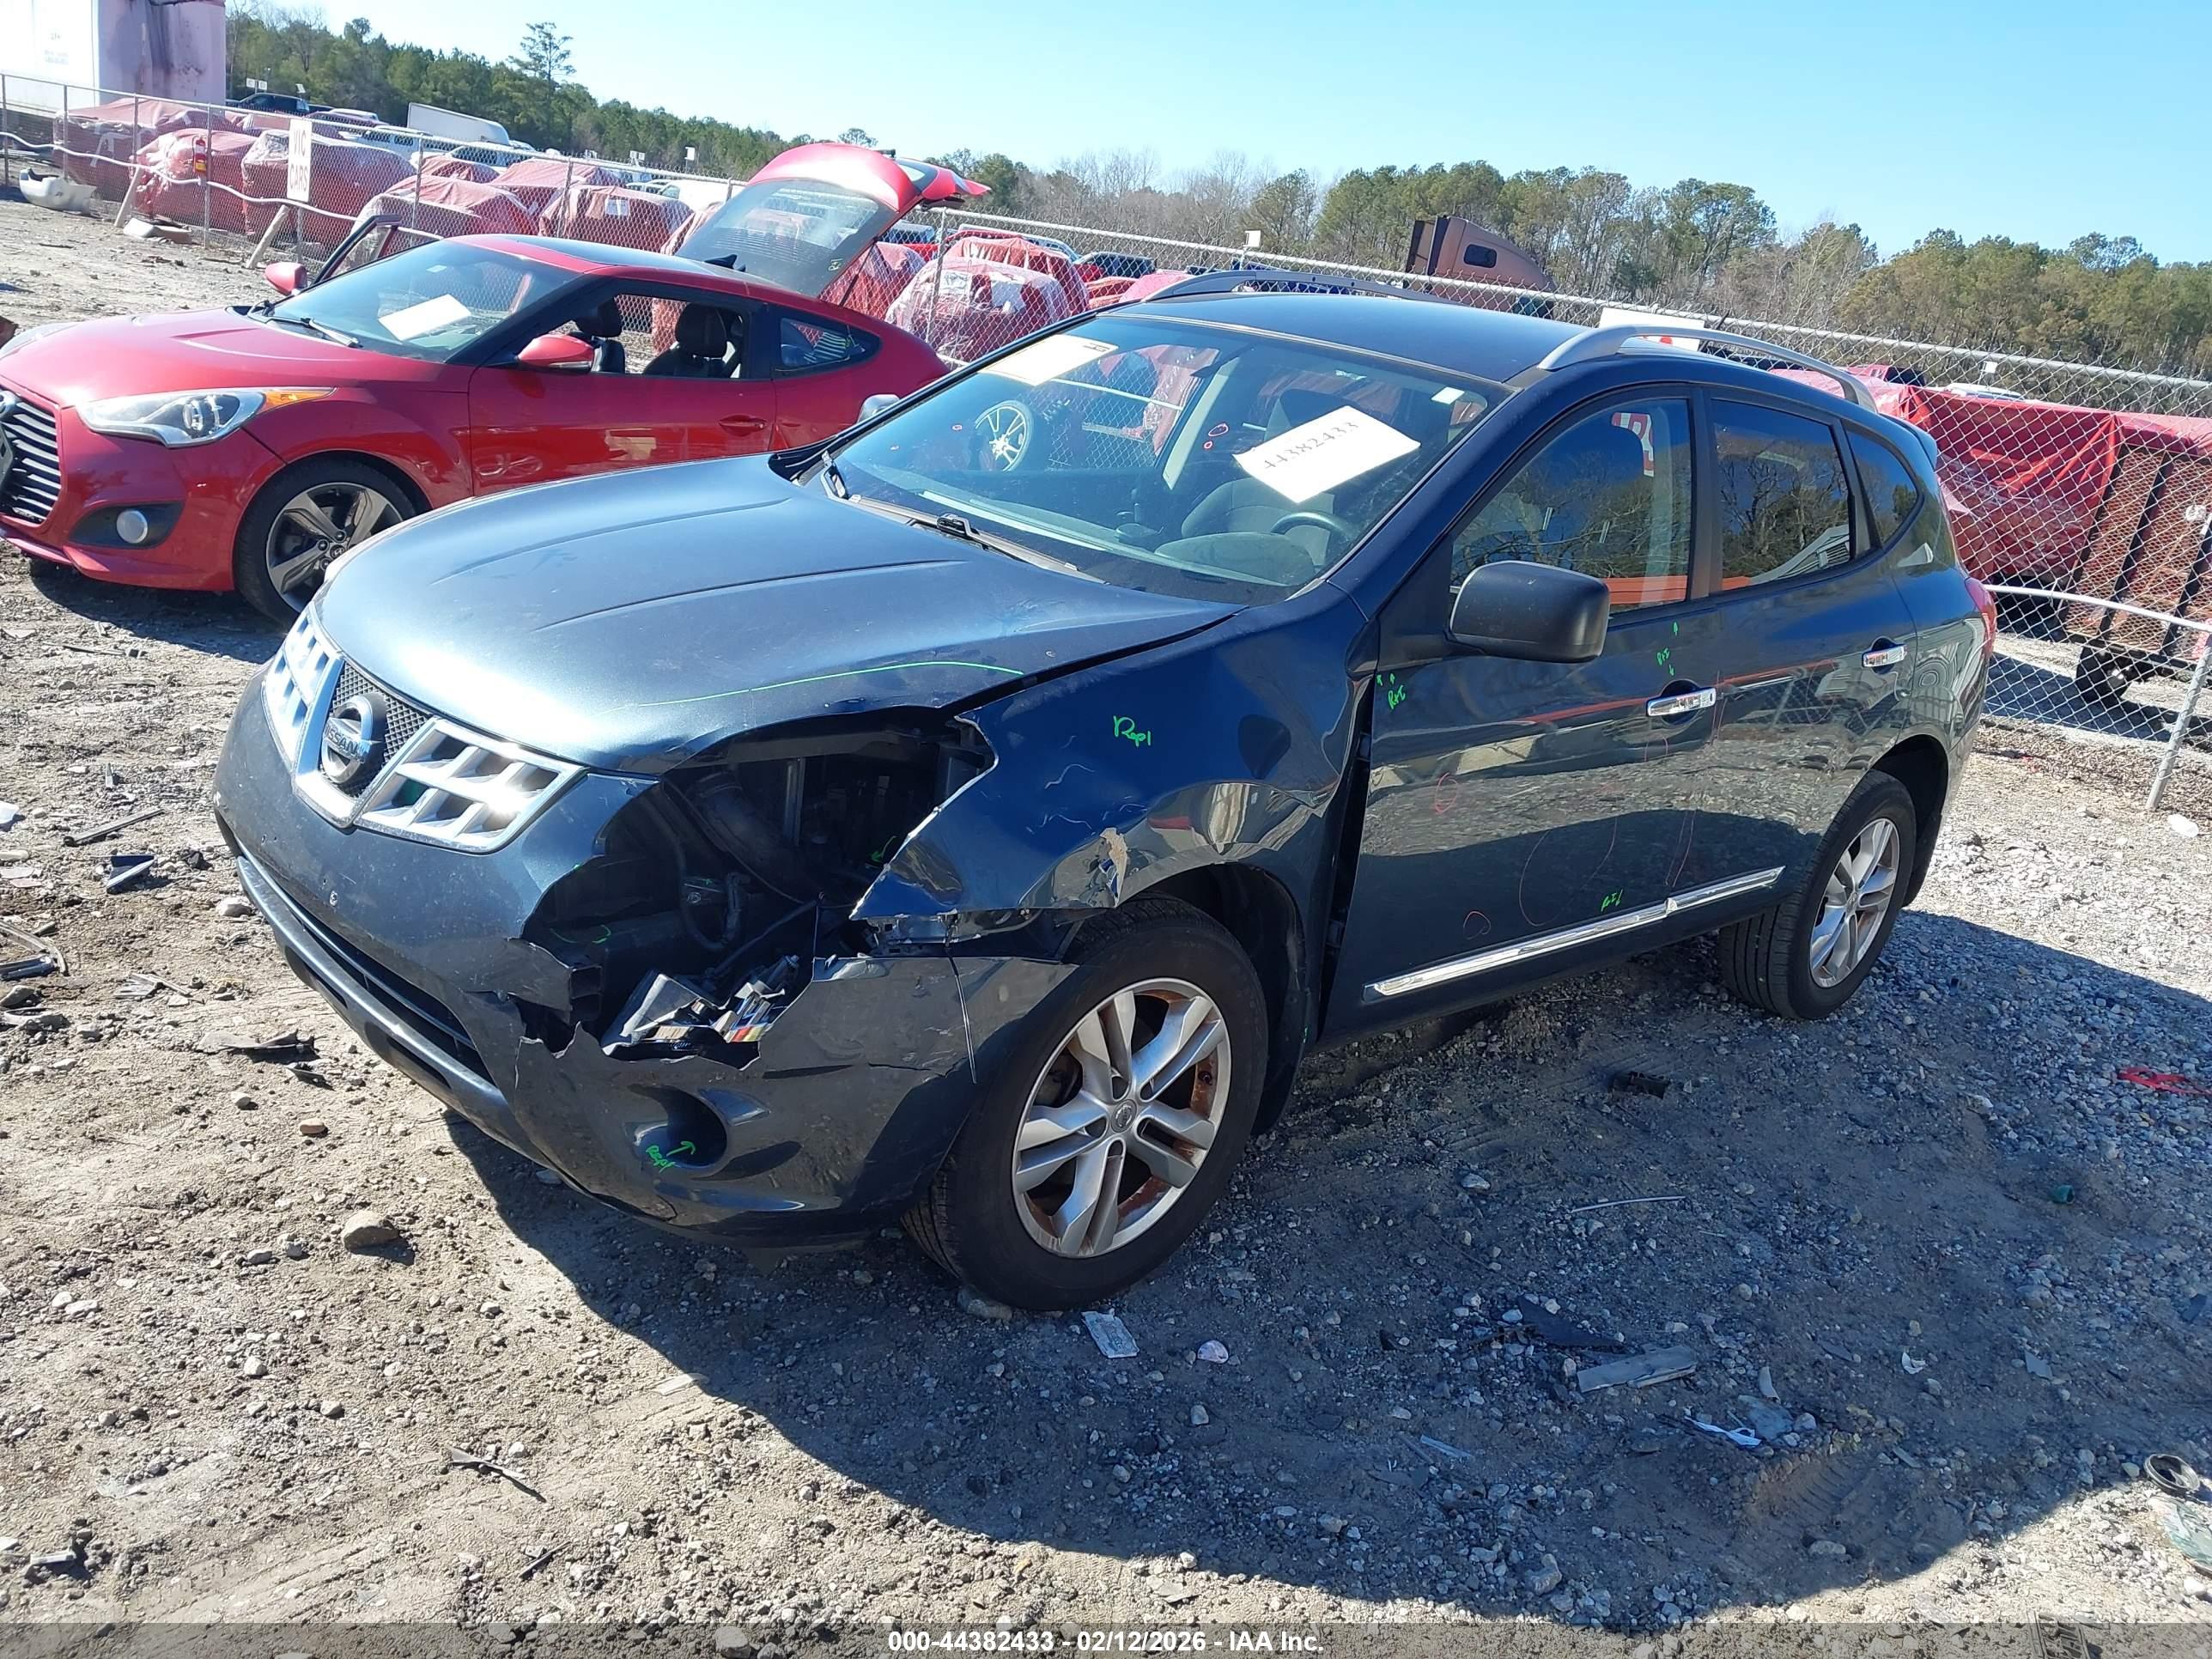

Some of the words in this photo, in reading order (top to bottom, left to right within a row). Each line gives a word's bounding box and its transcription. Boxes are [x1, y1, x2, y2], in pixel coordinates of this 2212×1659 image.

[294, 130, 307, 156] VIC
[289, 163, 308, 191] CARS
[1264, 421, 1359, 469] 44382433
